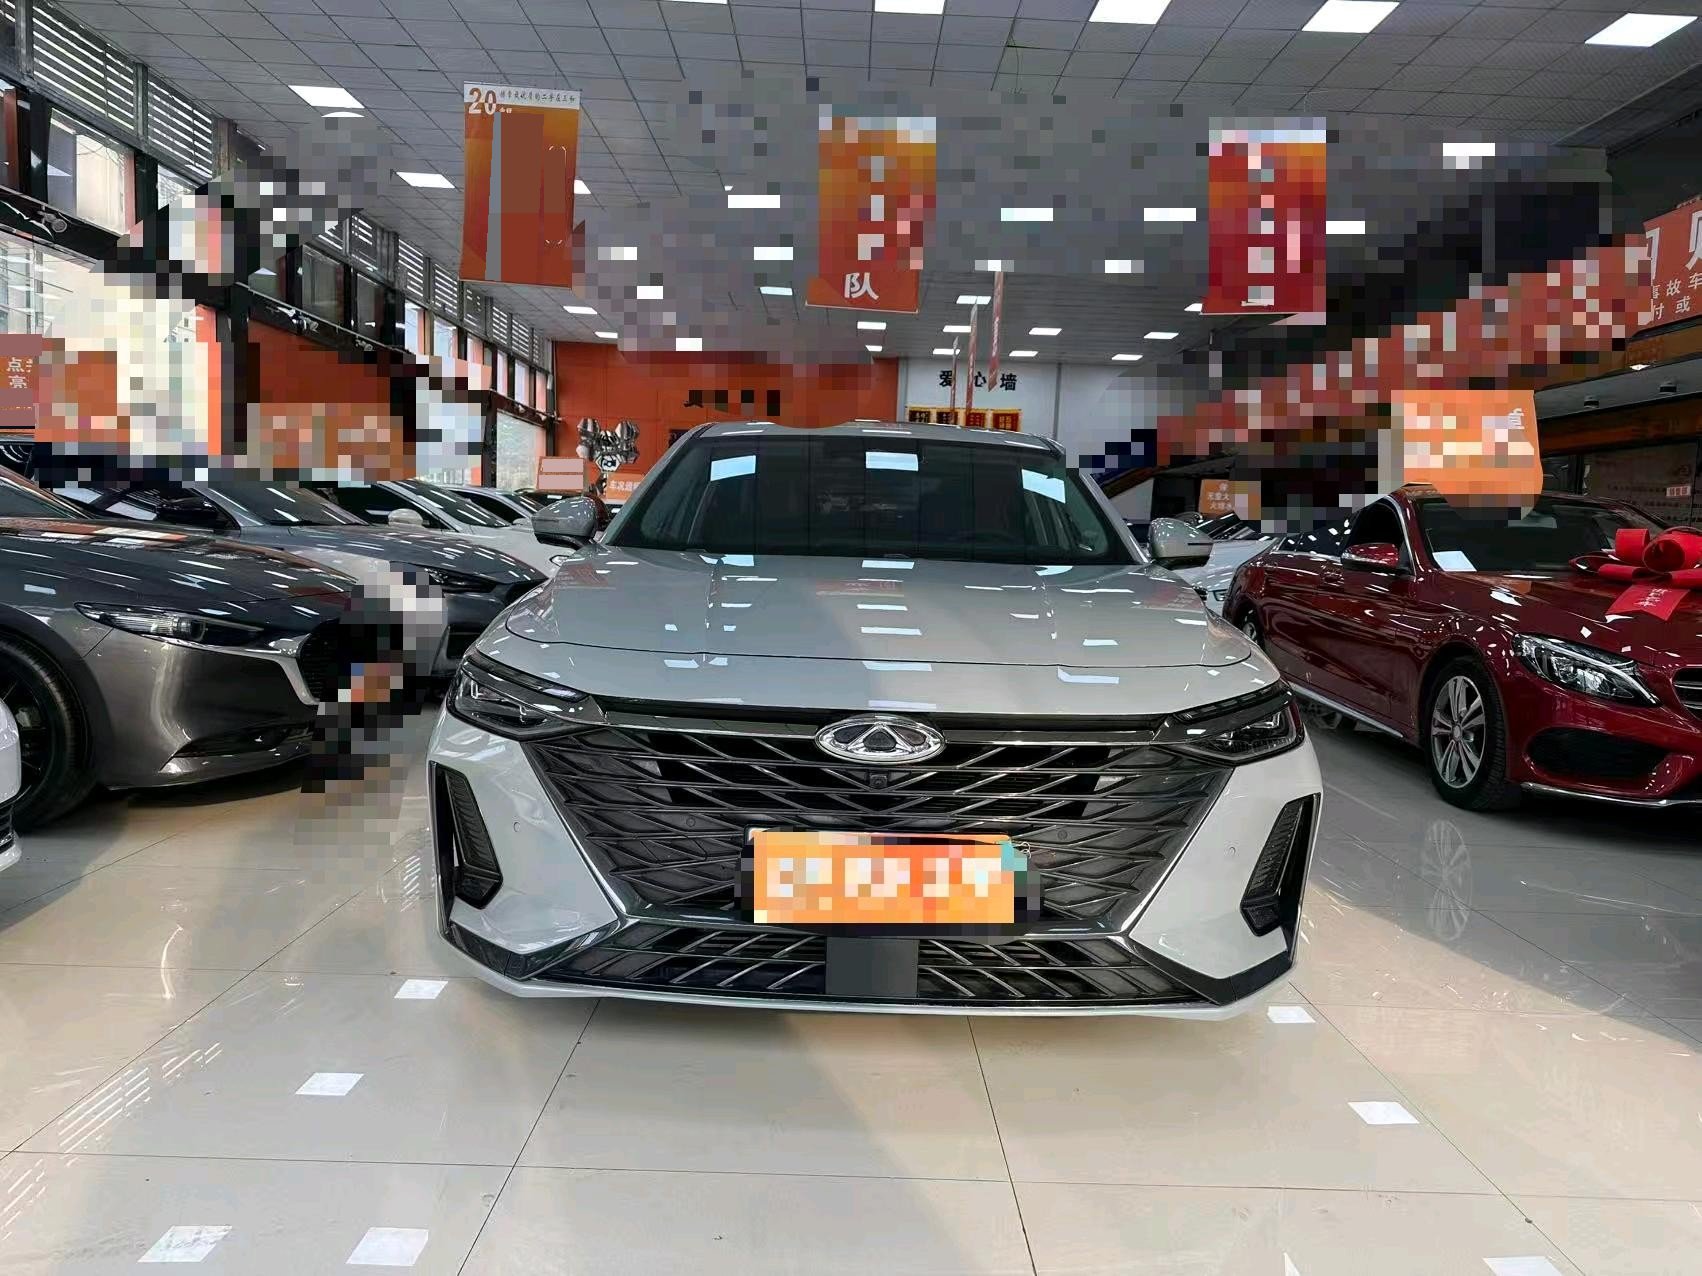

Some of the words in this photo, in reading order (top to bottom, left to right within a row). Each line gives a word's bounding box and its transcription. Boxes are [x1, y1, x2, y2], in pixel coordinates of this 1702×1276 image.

[469, 87, 497, 115] 20
[844, 271, 880, 301] 队
[939, 370, 1018, 391] 爱心墙
